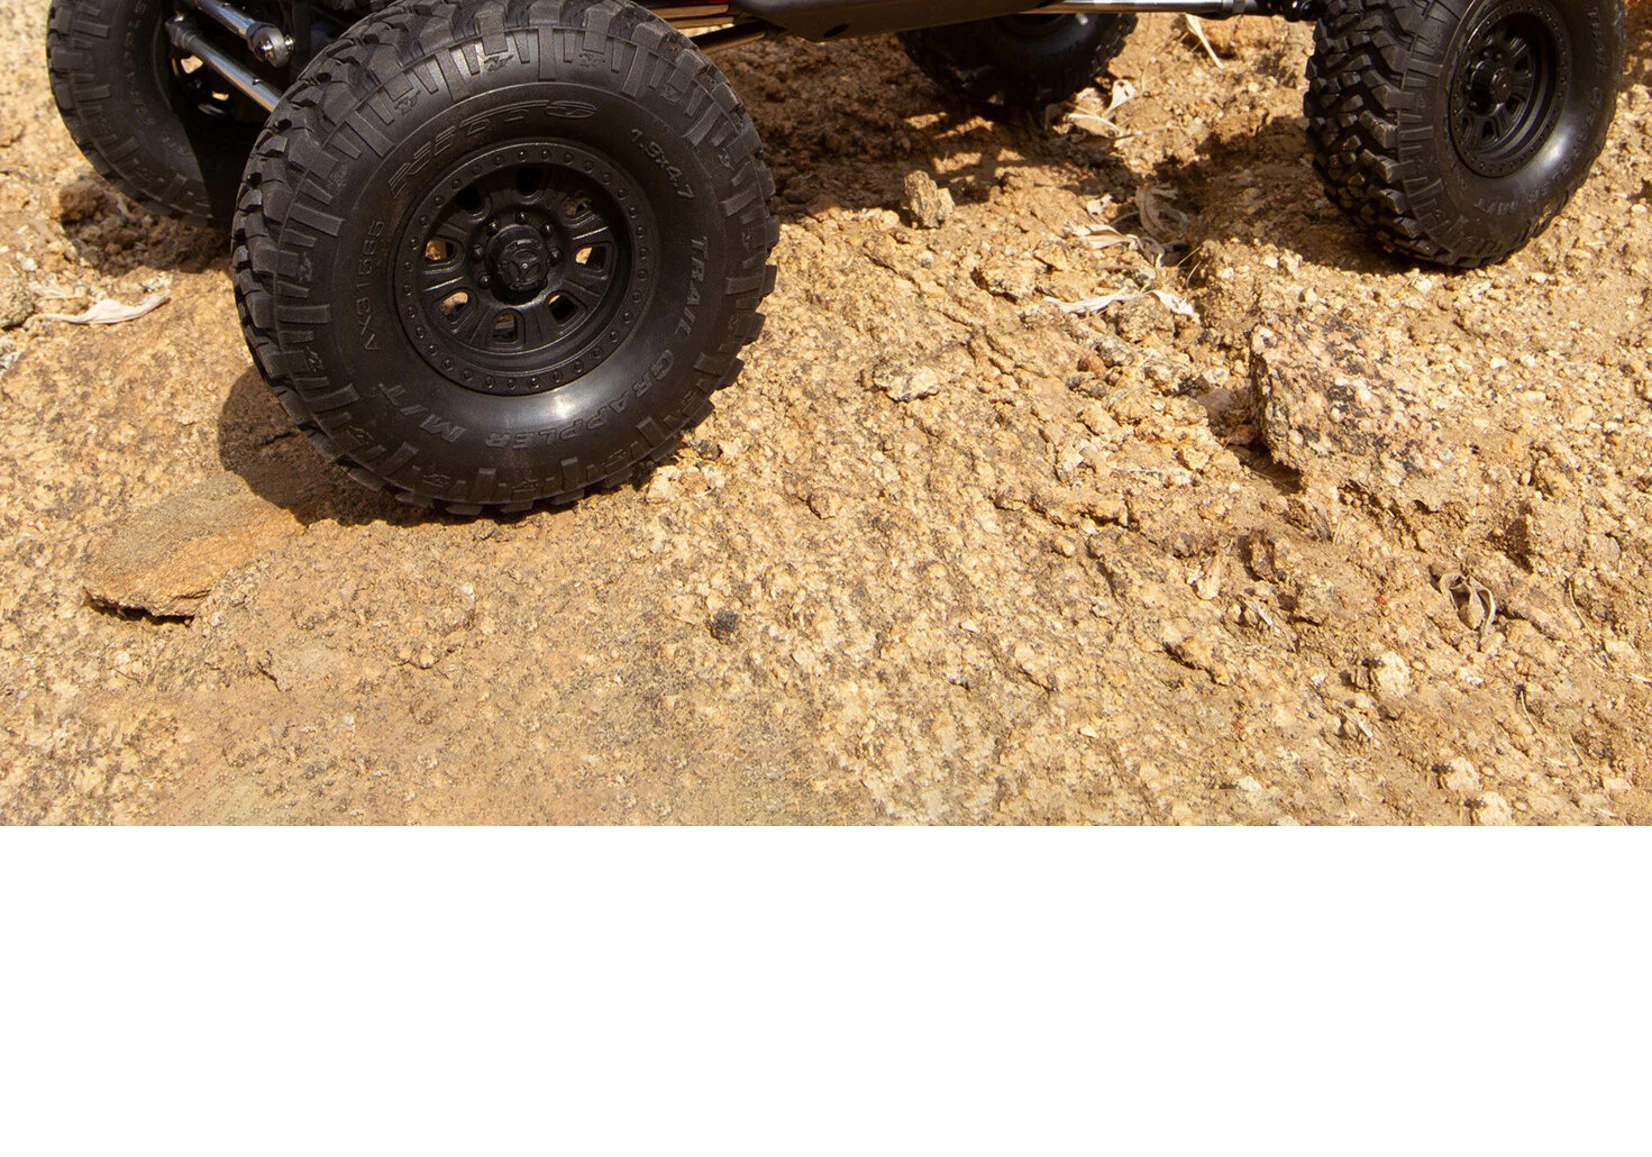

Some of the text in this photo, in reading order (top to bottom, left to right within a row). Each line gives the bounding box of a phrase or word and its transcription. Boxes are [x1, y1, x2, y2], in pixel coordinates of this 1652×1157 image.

[378, 234, 710, 449] TRAIL GRAPPLER M/T
